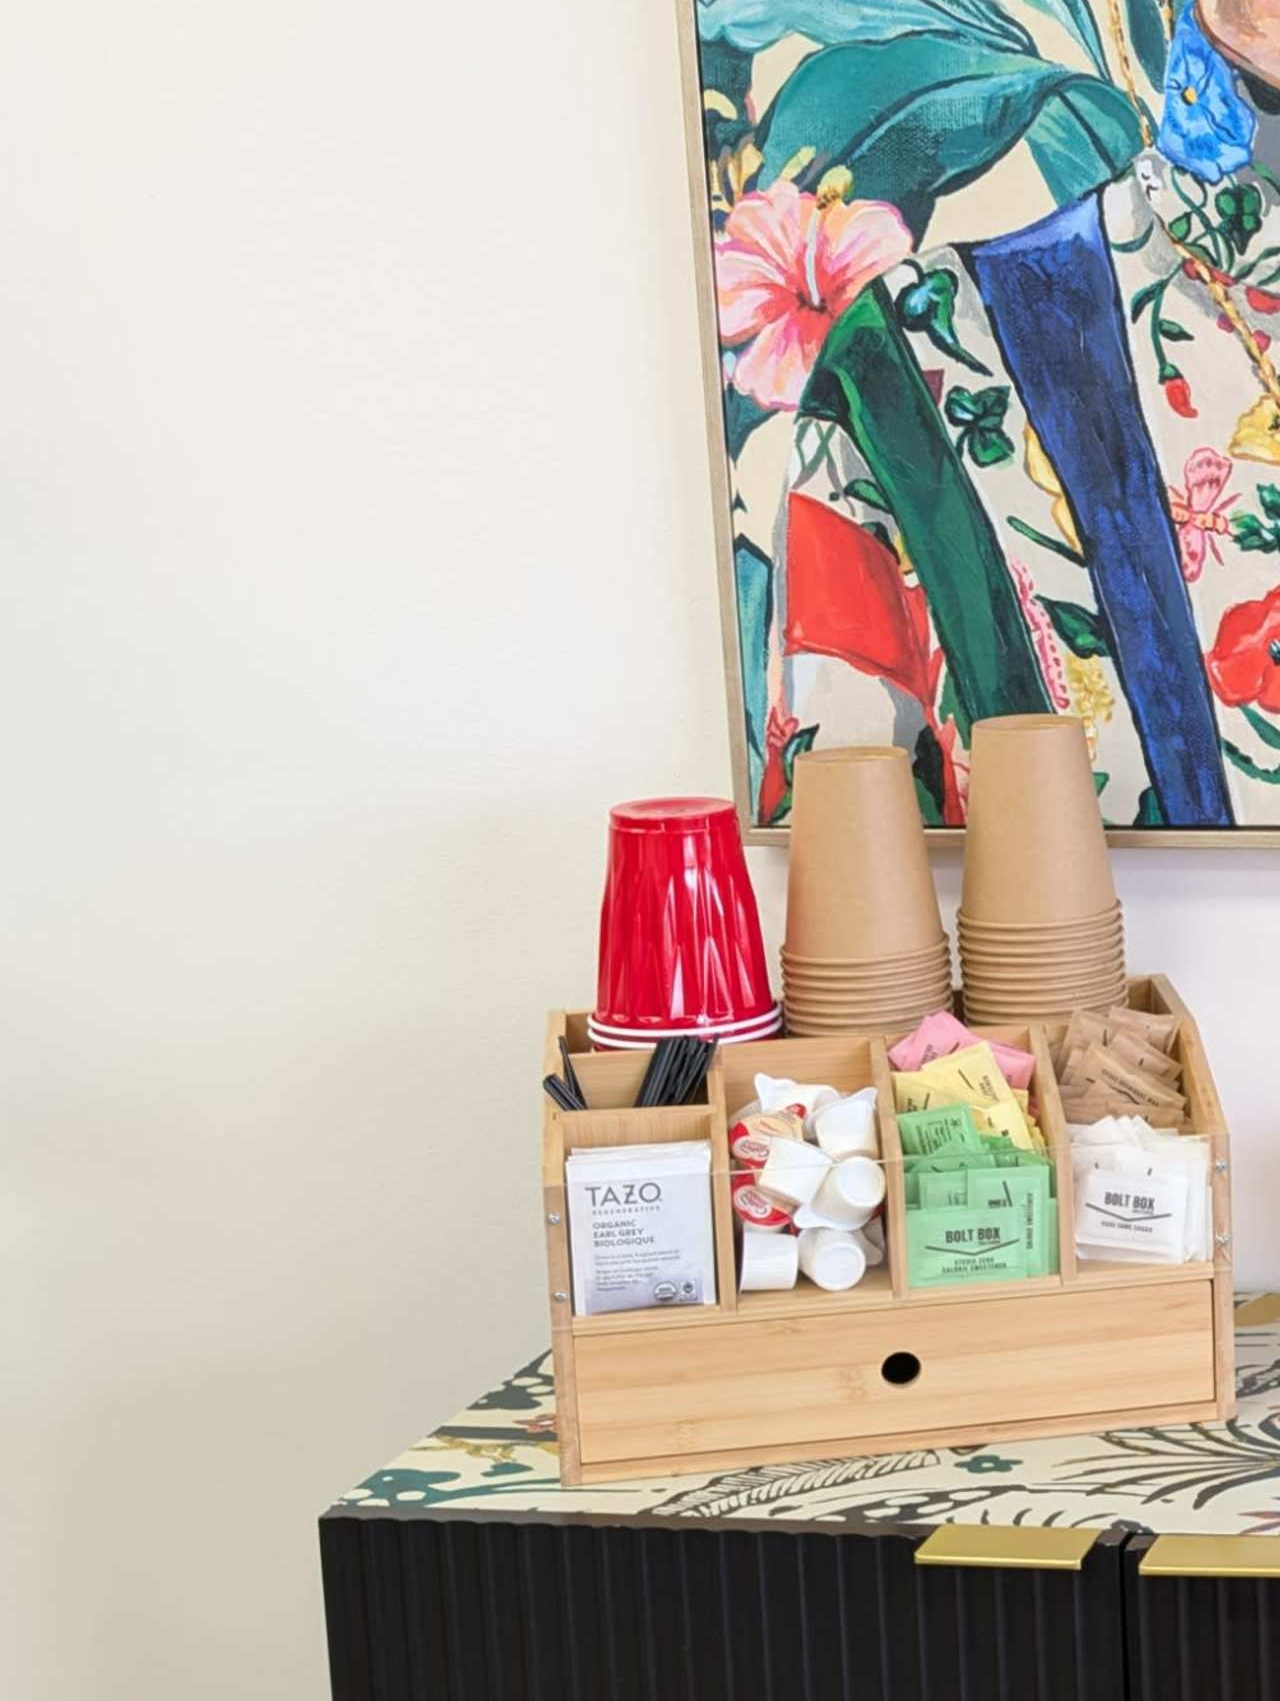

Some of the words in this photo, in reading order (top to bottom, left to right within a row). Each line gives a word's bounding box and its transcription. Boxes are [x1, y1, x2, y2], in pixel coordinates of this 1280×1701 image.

[584, 1182, 662, 1207] TAZO
[1104, 1191, 1131, 1208] BOLT
[1132, 1195, 1155, 1211] BOX
[592, 1218, 637, 1230] ORGANIC
[593, 1230, 617, 1239] EARL
[618, 1227, 644, 1237] GREY
[945, 1229, 974, 1244] BOLT
[977, 1226, 1001, 1241] BOX
[594, 1235, 655, 1248] BIOLOGIQUE
